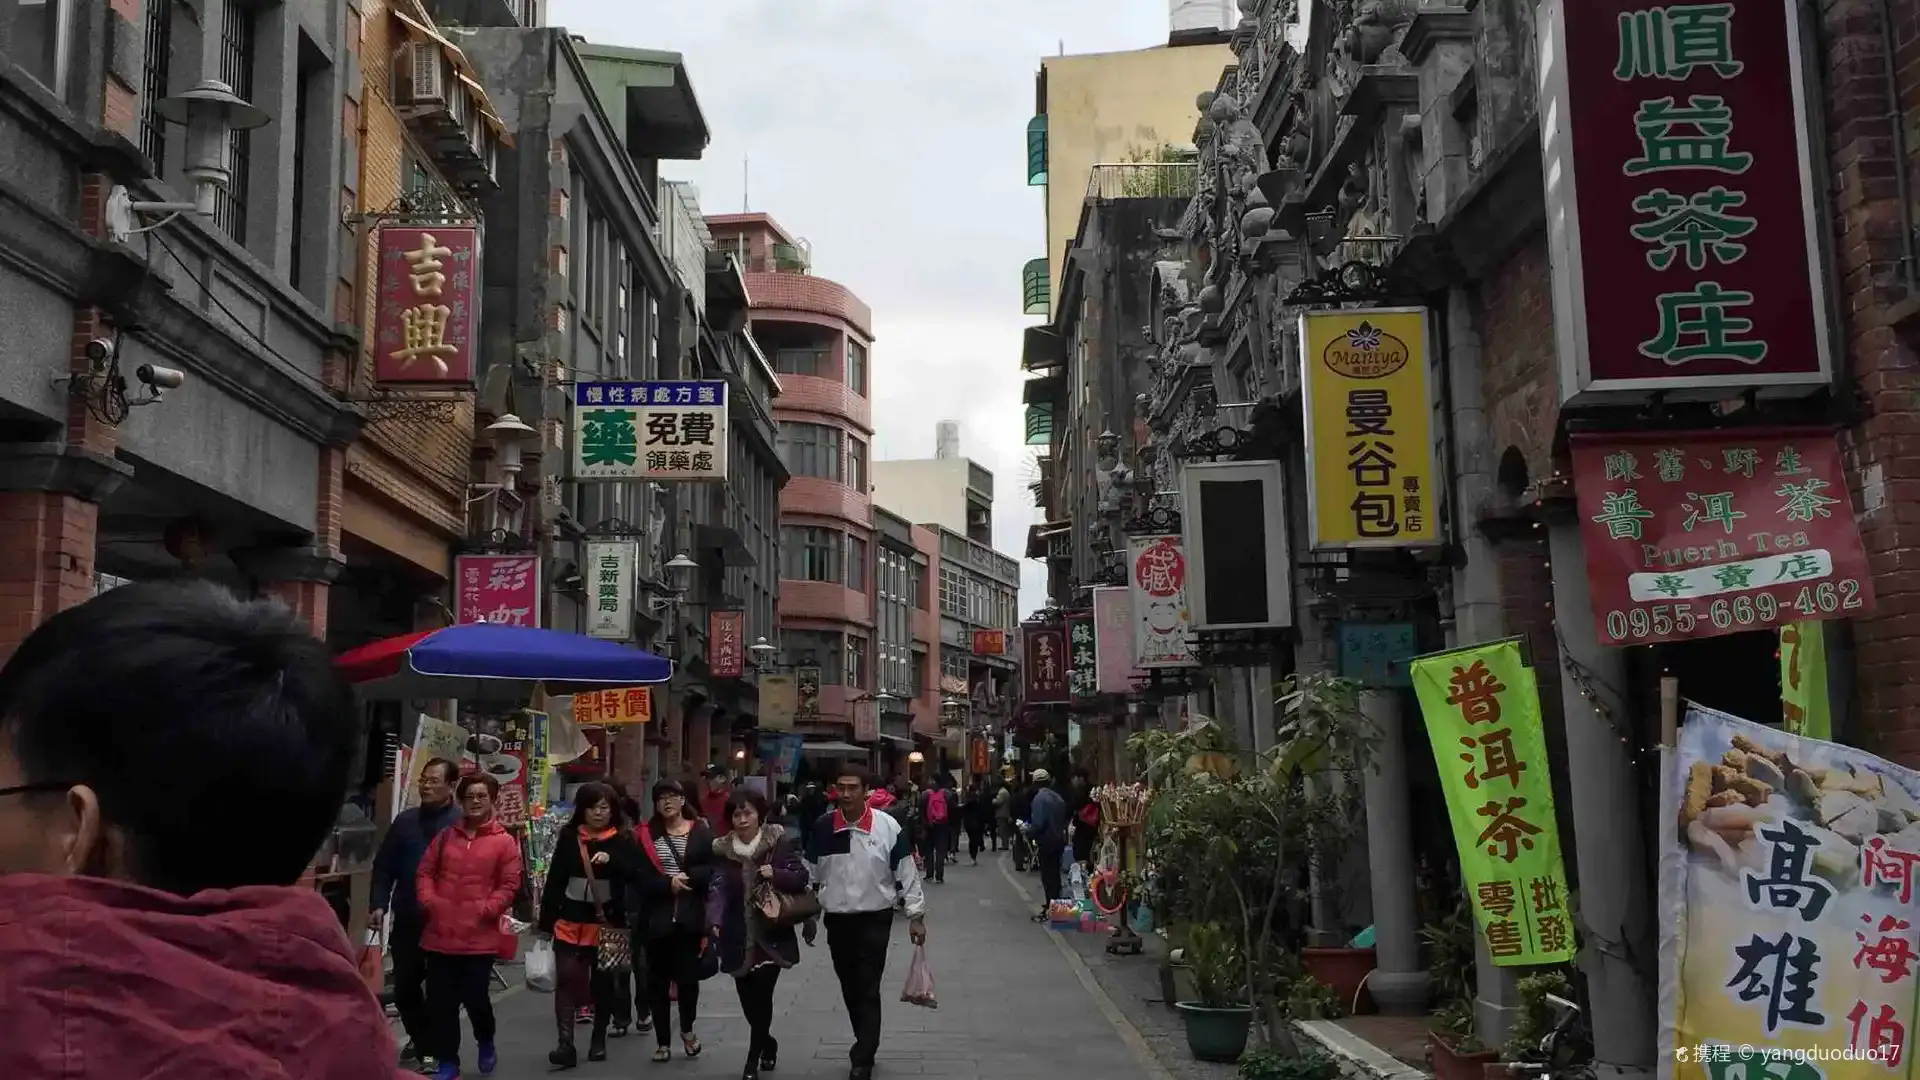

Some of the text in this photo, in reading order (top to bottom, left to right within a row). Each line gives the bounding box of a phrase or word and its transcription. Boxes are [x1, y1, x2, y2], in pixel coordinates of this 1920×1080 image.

[1613, 2, 1768, 364] 順益茶庄
[389, 232, 459, 378] 吉興
[1332, 348, 1402, 369] Maniya
[582, 409, 637, 467] 藥
[646, 412, 714, 446] 免費
[646, 450, 713, 472] 領藥處
[1346, 389, 1399, 537] 曼谷包
[1402, 476, 1423, 532] 專賣店
[1592, 478, 1842, 541] 普洱茶
[1641, 531, 1810, 568] Puerh Tea
[1648, 555, 1822, 597] 專賣店
[597, 555, 619, 613] 吉新藥局
[1606, 579, 1863, 640] 0955-669-462
[594, 690, 649, 718] 特價
[1445, 659, 1544, 863] 普洱茶
[1477, 879, 1523, 957] 零售
[1530, 874, 1566, 953] 批發
[1726, 820, 1831, 1032] 高雄
